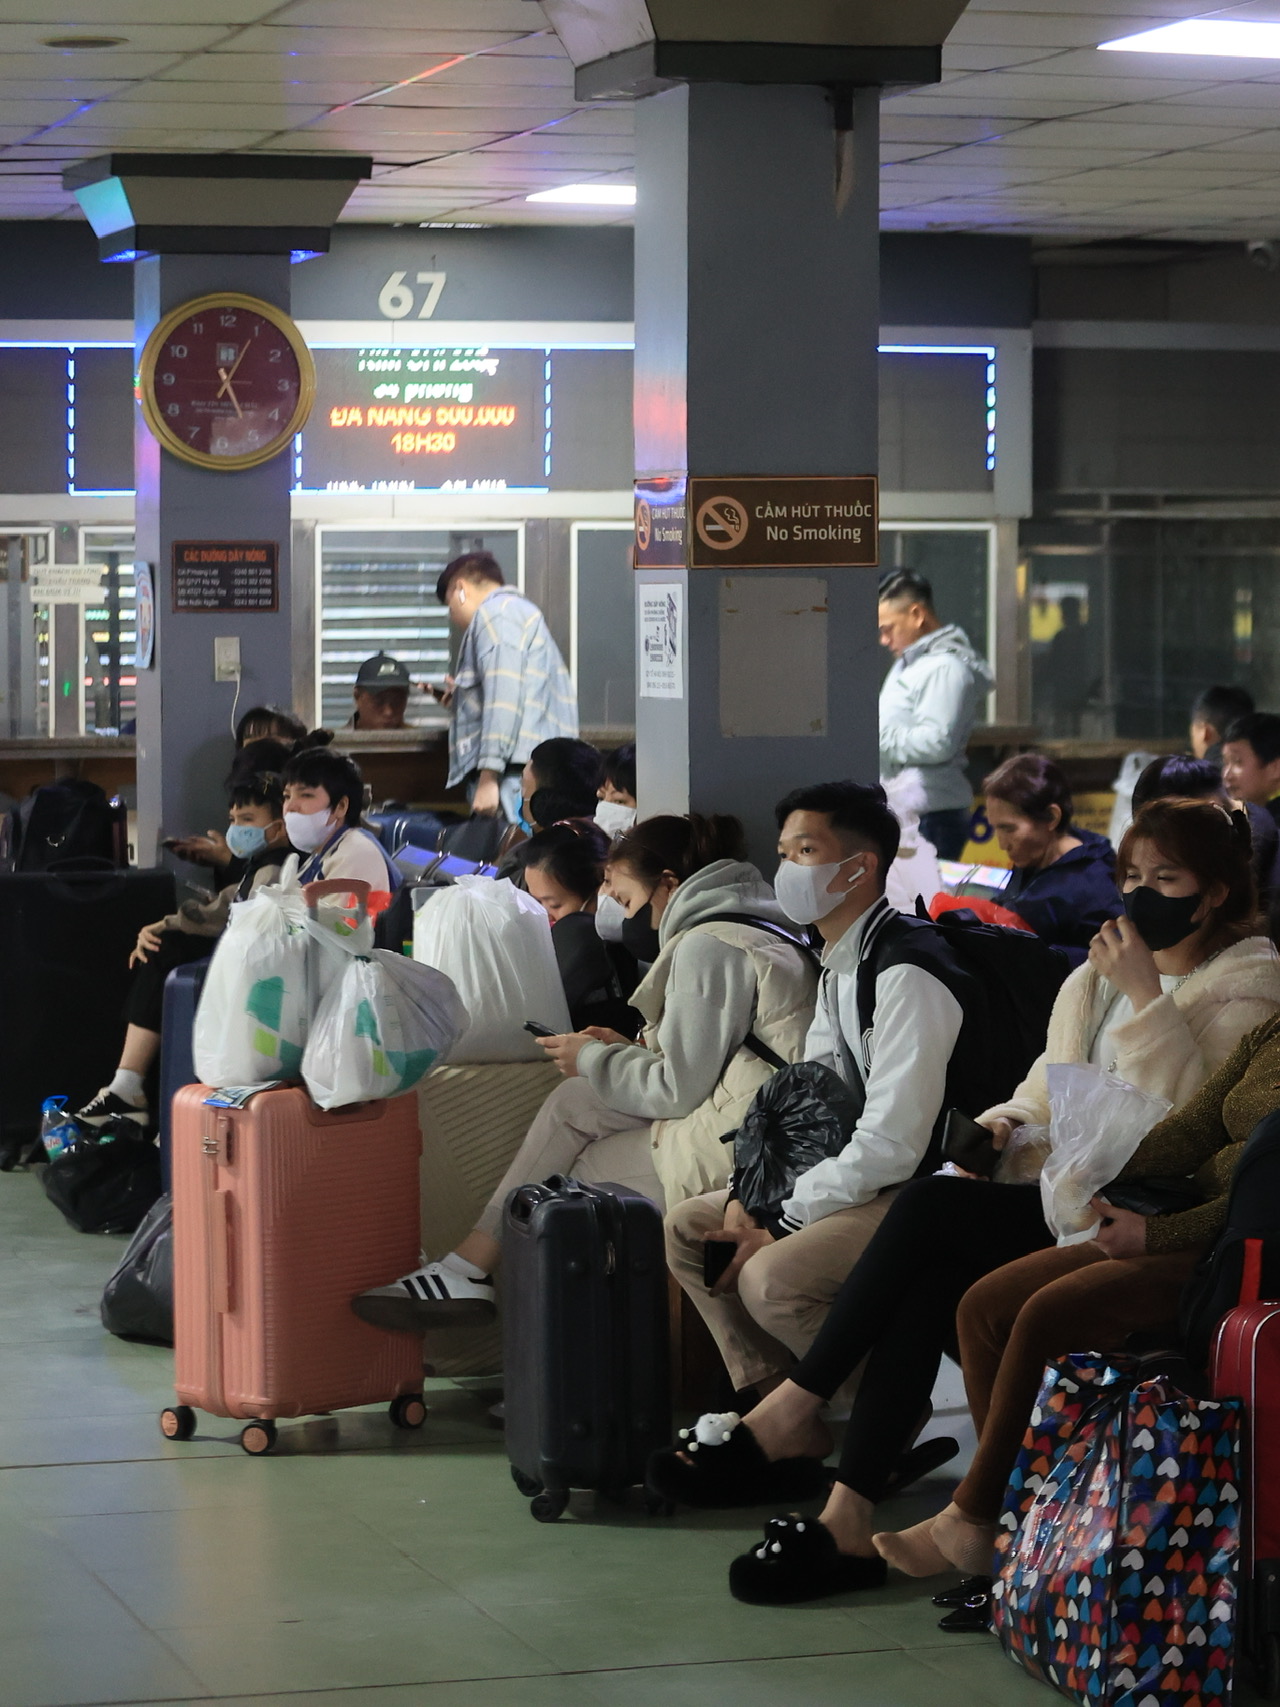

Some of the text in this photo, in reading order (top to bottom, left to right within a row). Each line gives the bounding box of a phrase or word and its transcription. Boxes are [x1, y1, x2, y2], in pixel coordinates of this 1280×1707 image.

[378, 270, 446, 319] 67
[219, 315, 237, 328] 12
[193, 323, 203, 335] 11
[170, 345, 188, 358] 10
[269, 349, 282, 363] 2
[162, 372, 175, 386] 9
[277, 379, 290, 392] 3
[167, 402, 180, 417] 8
[268, 407, 279, 422] 4
[189, 426, 200, 439] 7
[216, 436, 229, 449] 6
[391, 431, 456, 453] 18H30
[791, 502, 819, 519] HÚT
[824, 500, 873, 518] THUỐC
[662, 526, 683, 545] Smoking
[766, 525, 862, 544] No Smoking
